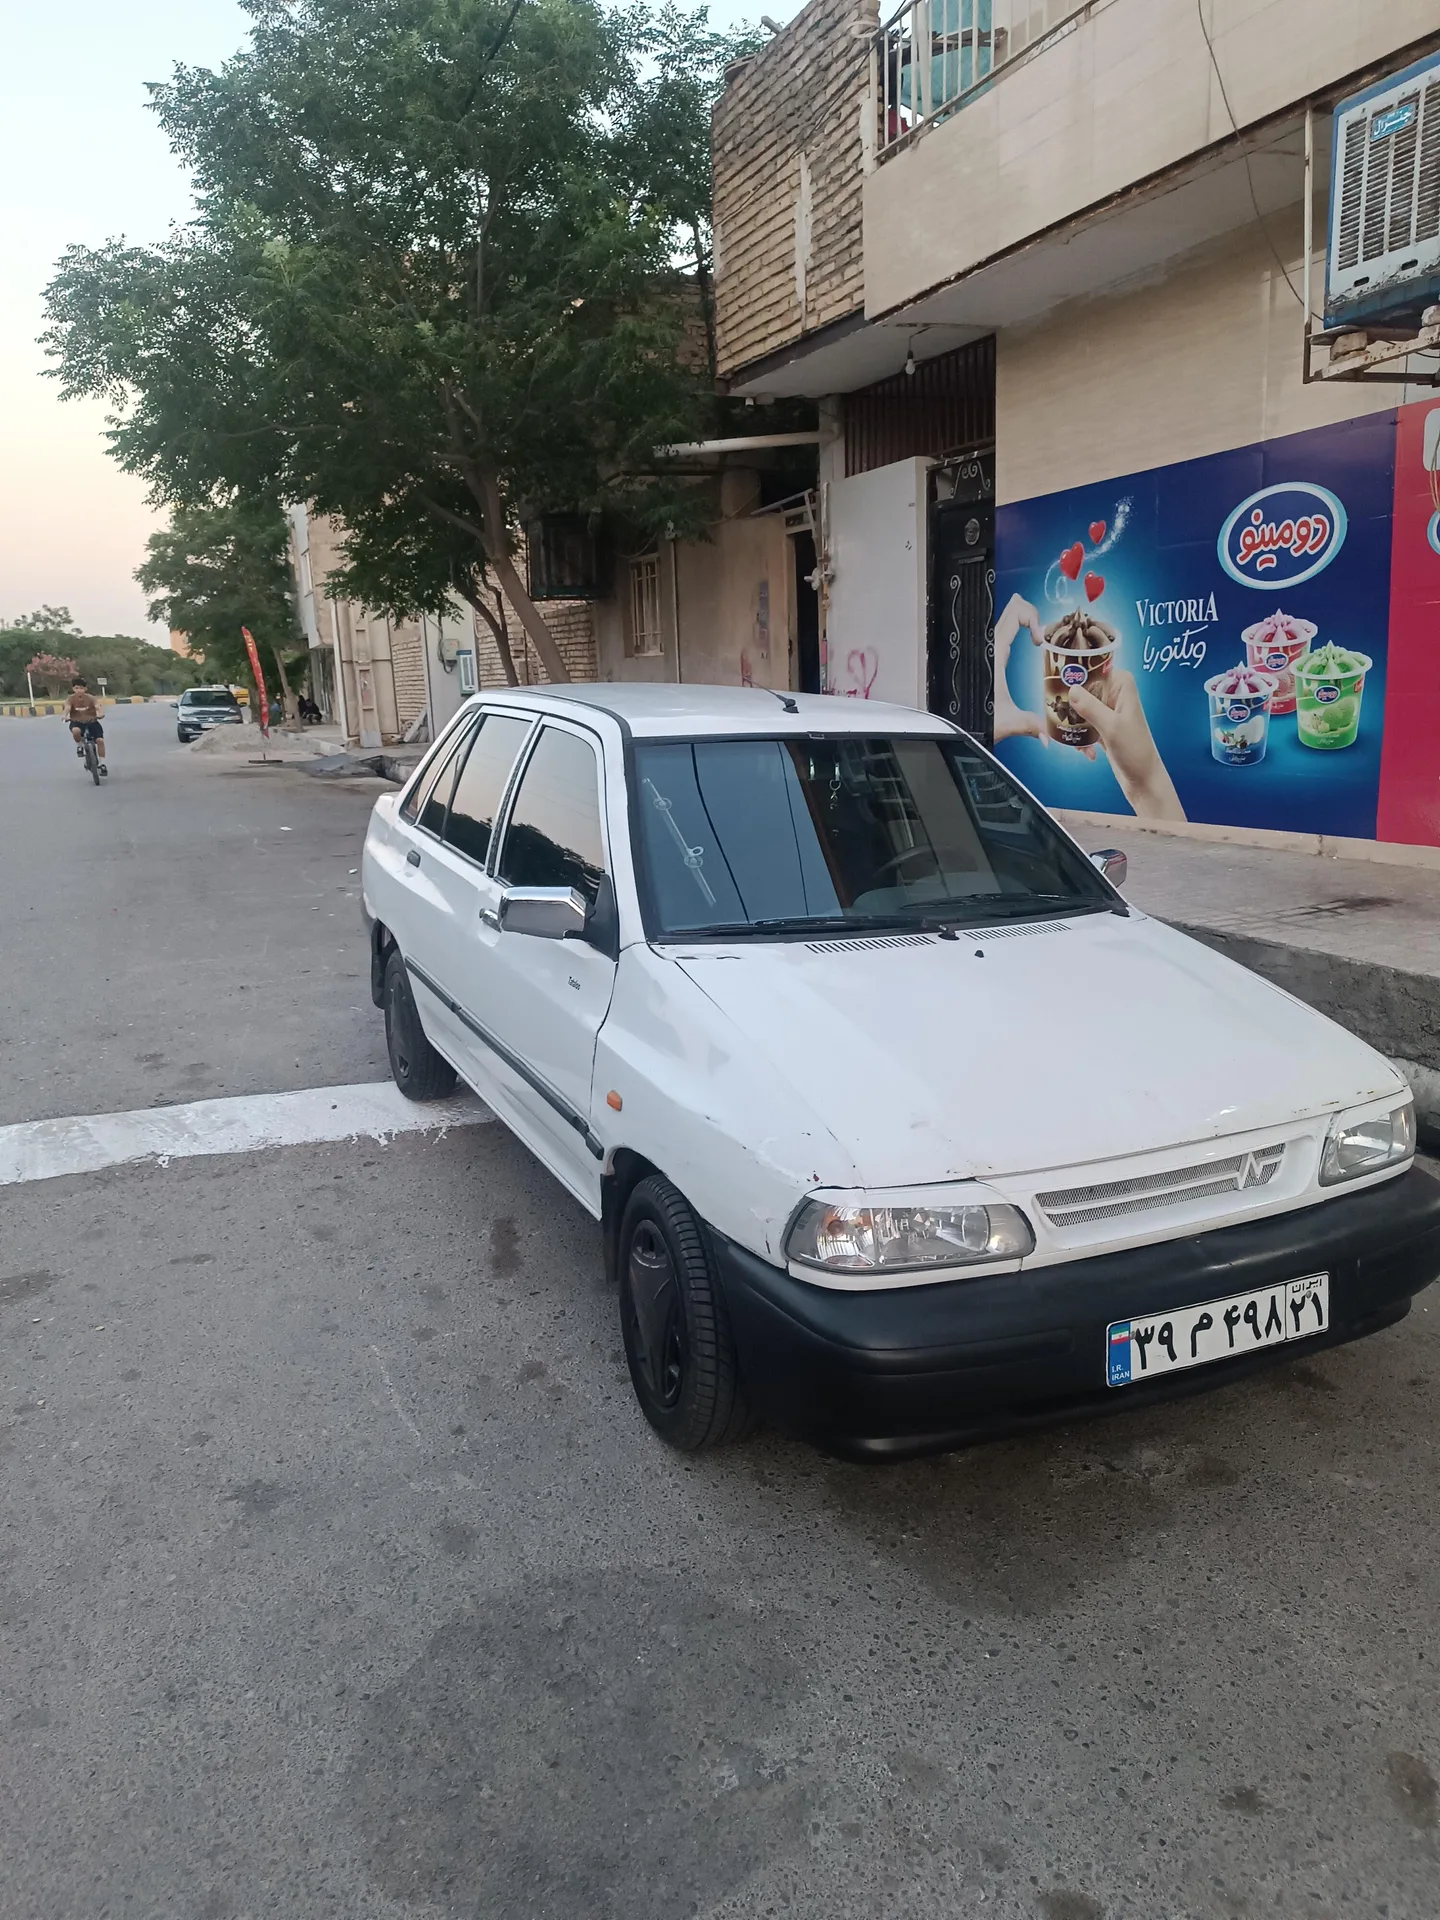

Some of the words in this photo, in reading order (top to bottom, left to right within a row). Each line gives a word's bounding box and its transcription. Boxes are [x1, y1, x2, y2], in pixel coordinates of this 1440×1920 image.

[1374, 110, 1412, 136] جنرال
[1237, 509, 1329, 571] دومینو
[1143, 624, 1209, 673] ویکتوریا
[1291, 1278, 1322, 1294] ایران
[1111, 1370, 1130, 1381] IRAN
